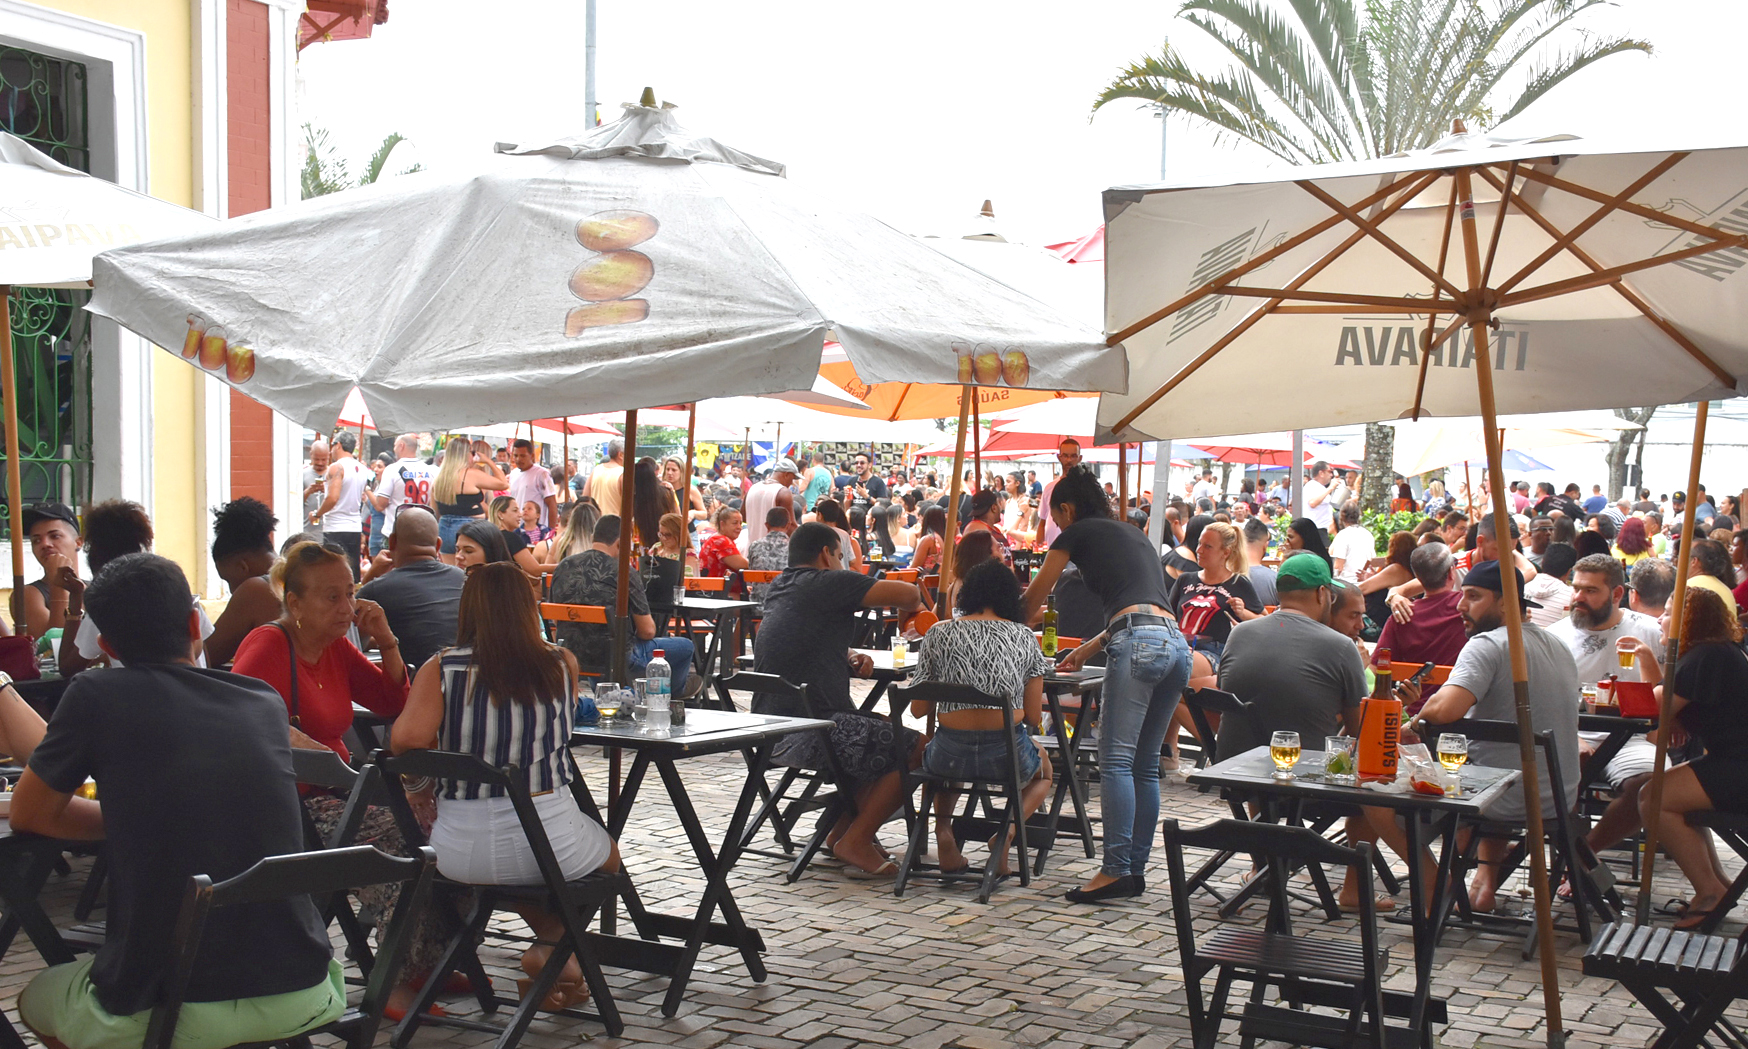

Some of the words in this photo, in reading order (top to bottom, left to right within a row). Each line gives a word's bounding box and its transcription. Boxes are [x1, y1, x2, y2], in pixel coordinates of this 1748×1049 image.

[402, 471, 430, 479] CAIXA
[404, 480, 429, 505] 98
[1378, 712, 1399, 768] SAÚDIS!
